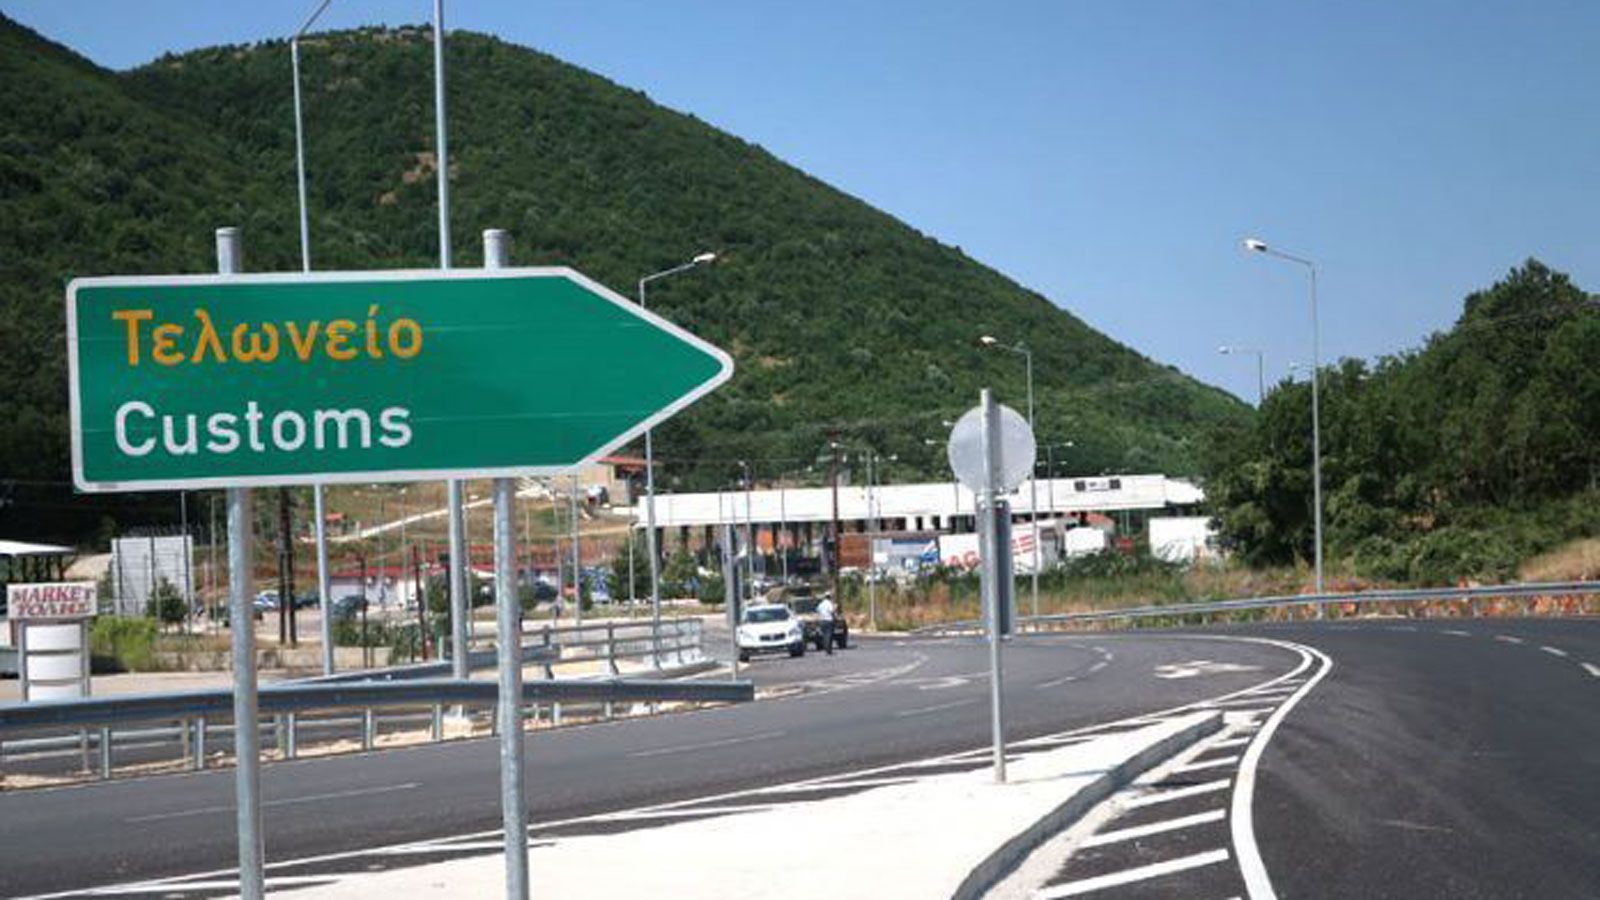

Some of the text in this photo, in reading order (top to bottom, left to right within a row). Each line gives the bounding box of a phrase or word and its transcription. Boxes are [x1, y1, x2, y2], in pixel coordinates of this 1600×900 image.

[112, 304, 424, 367] Τελωνείο
[114, 401, 413, 456] Customs
[12, 586, 95, 603] MARKET
